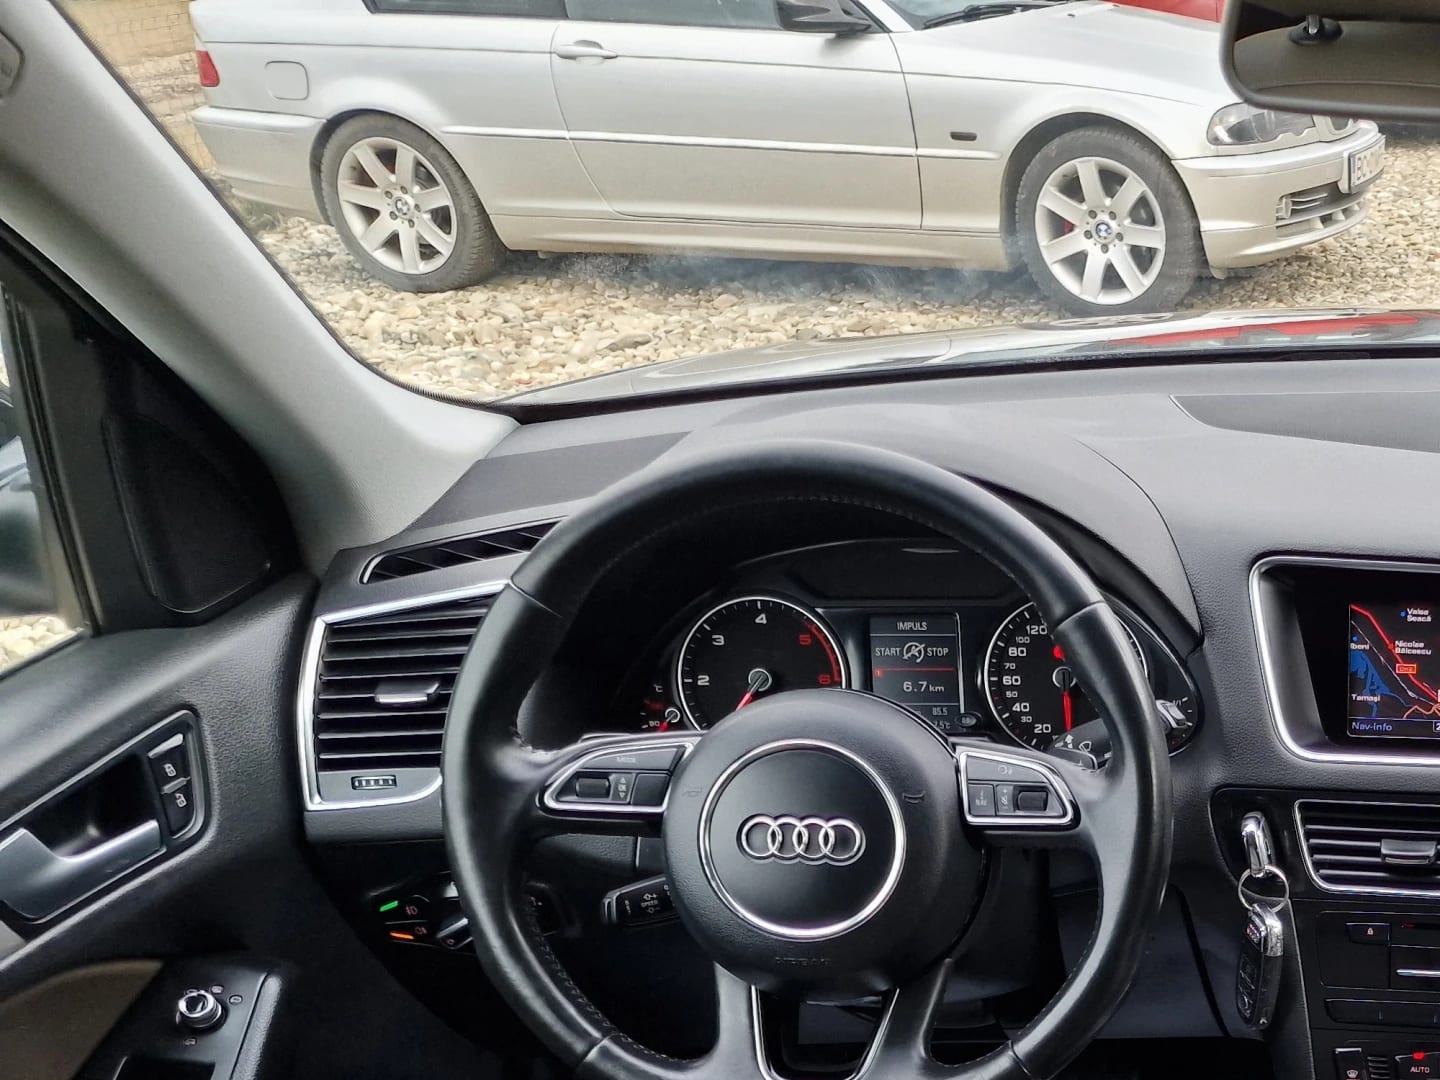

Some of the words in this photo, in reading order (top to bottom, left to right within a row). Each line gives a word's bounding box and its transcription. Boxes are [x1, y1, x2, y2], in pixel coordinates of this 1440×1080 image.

[755, 613, 767, 624] 4
[897, 621, 928, 631] IMPULS
[1026, 625, 1048, 635] 120
[712, 635, 725, 646] 3
[799, 634, 811, 645] 5
[1016, 636, 1030, 644] 100
[875, 648, 901, 656] START
[927, 648, 949, 656] STOP
[1008, 647, 1027, 657] 80
[697, 675, 710, 686] 2
[818, 675, 831, 685] 6
[1003, 676, 1021, 685] 60
[903, 681, 928, 692] 6.7
[929, 684, 945, 692] km
[1012, 703, 1030, 712] 40
[1033, 724, 1052, 734] 20
